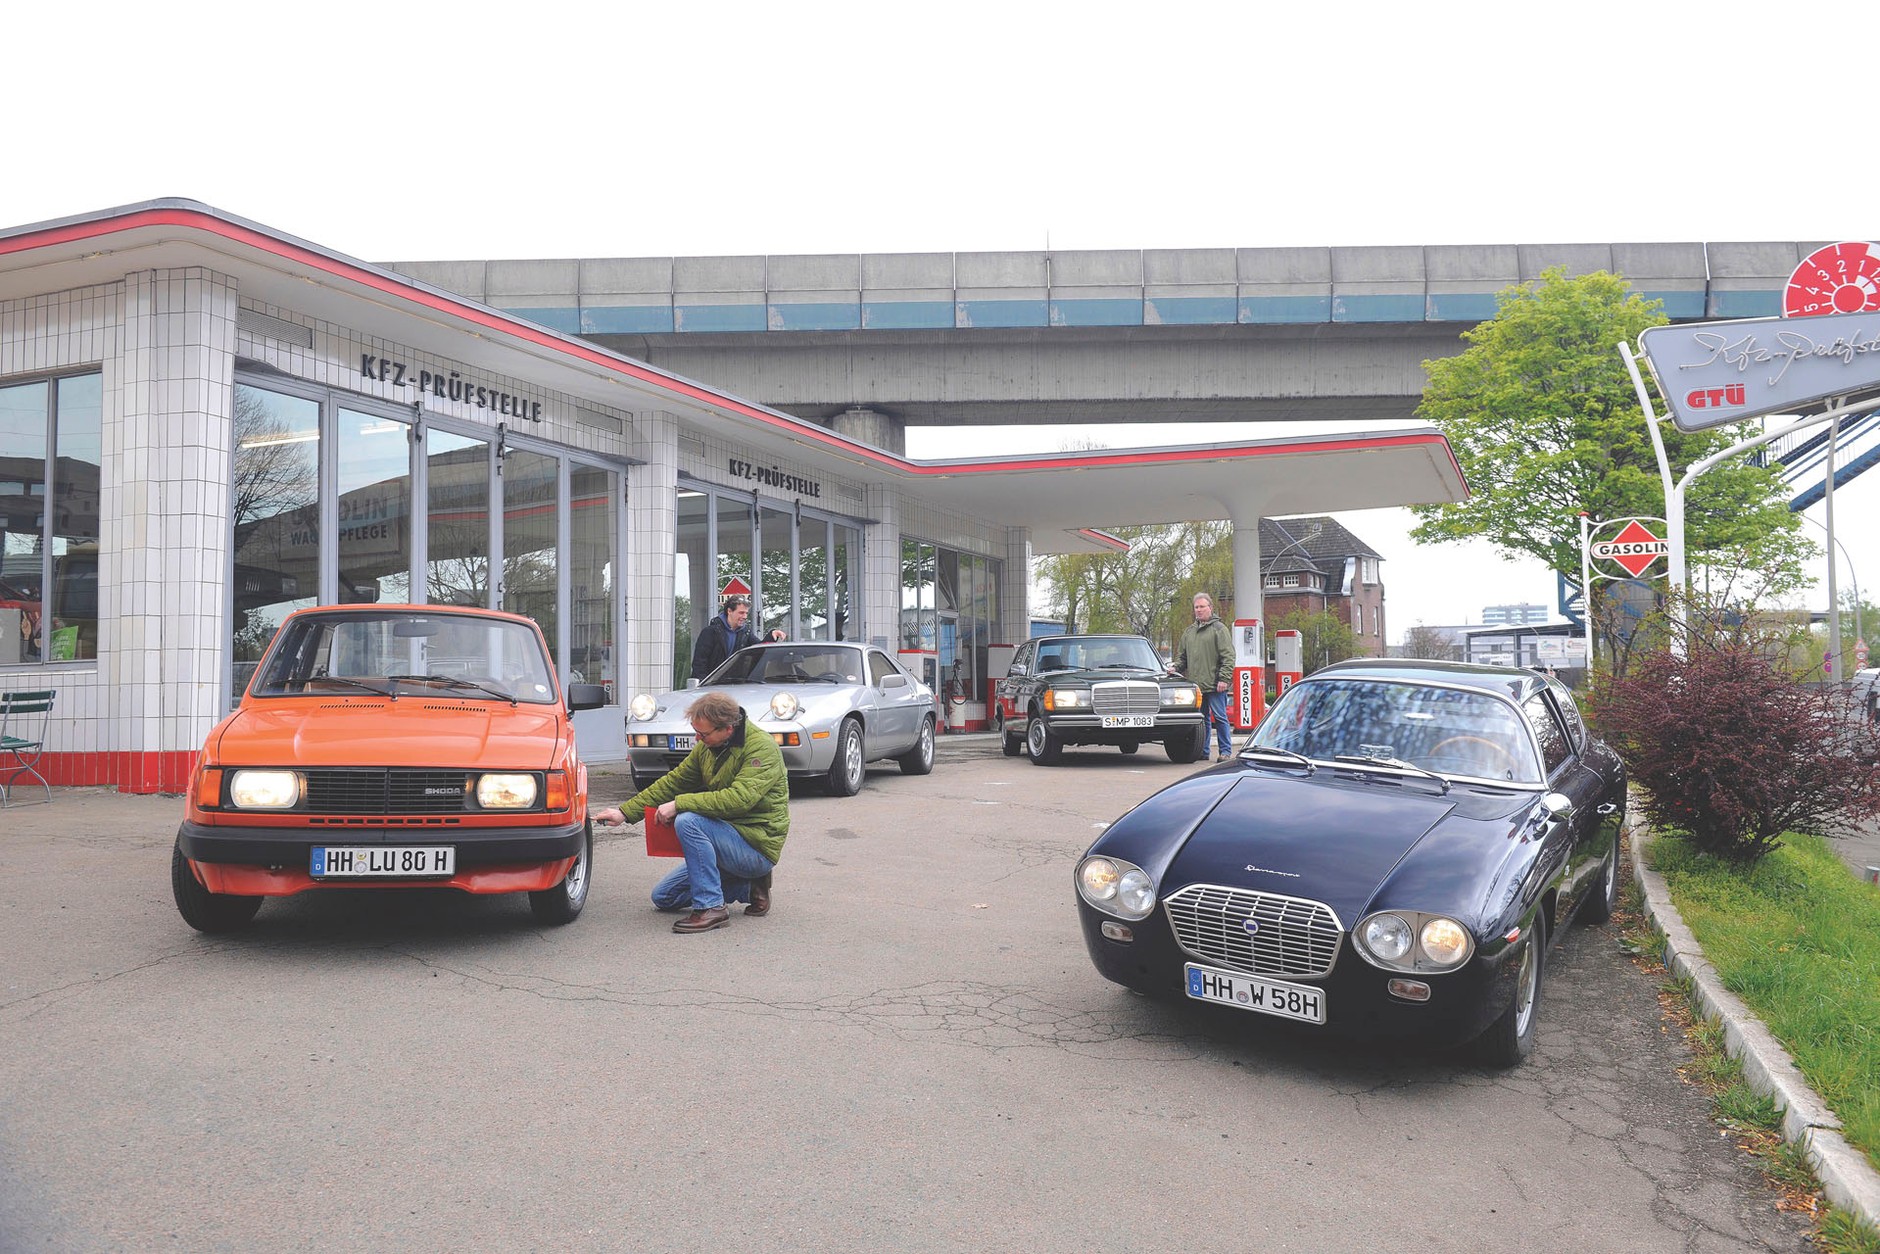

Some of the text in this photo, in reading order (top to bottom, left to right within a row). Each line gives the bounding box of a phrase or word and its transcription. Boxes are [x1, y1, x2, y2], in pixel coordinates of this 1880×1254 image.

[362, 353, 542, 423] KFZ-PRÜFSTELLE
[1686, 383, 1745, 409] GTÜ
[729, 458, 820, 498] KFZ-PRÜFSTELLE
[1599, 542, 1669, 555] GASOLIN
[1241, 672, 1250, 725] GASOLIN
[675, 737, 689, 748] HH
[327, 851, 353, 872] HH
[369, 851, 395, 872] LU
[401, 851, 426, 872] 80
[434, 851, 447, 872] H
[1202, 973, 1234, 1000] HH
[1250, 983, 1265, 1006] W
[1271, 987, 1318, 1018] 58H
